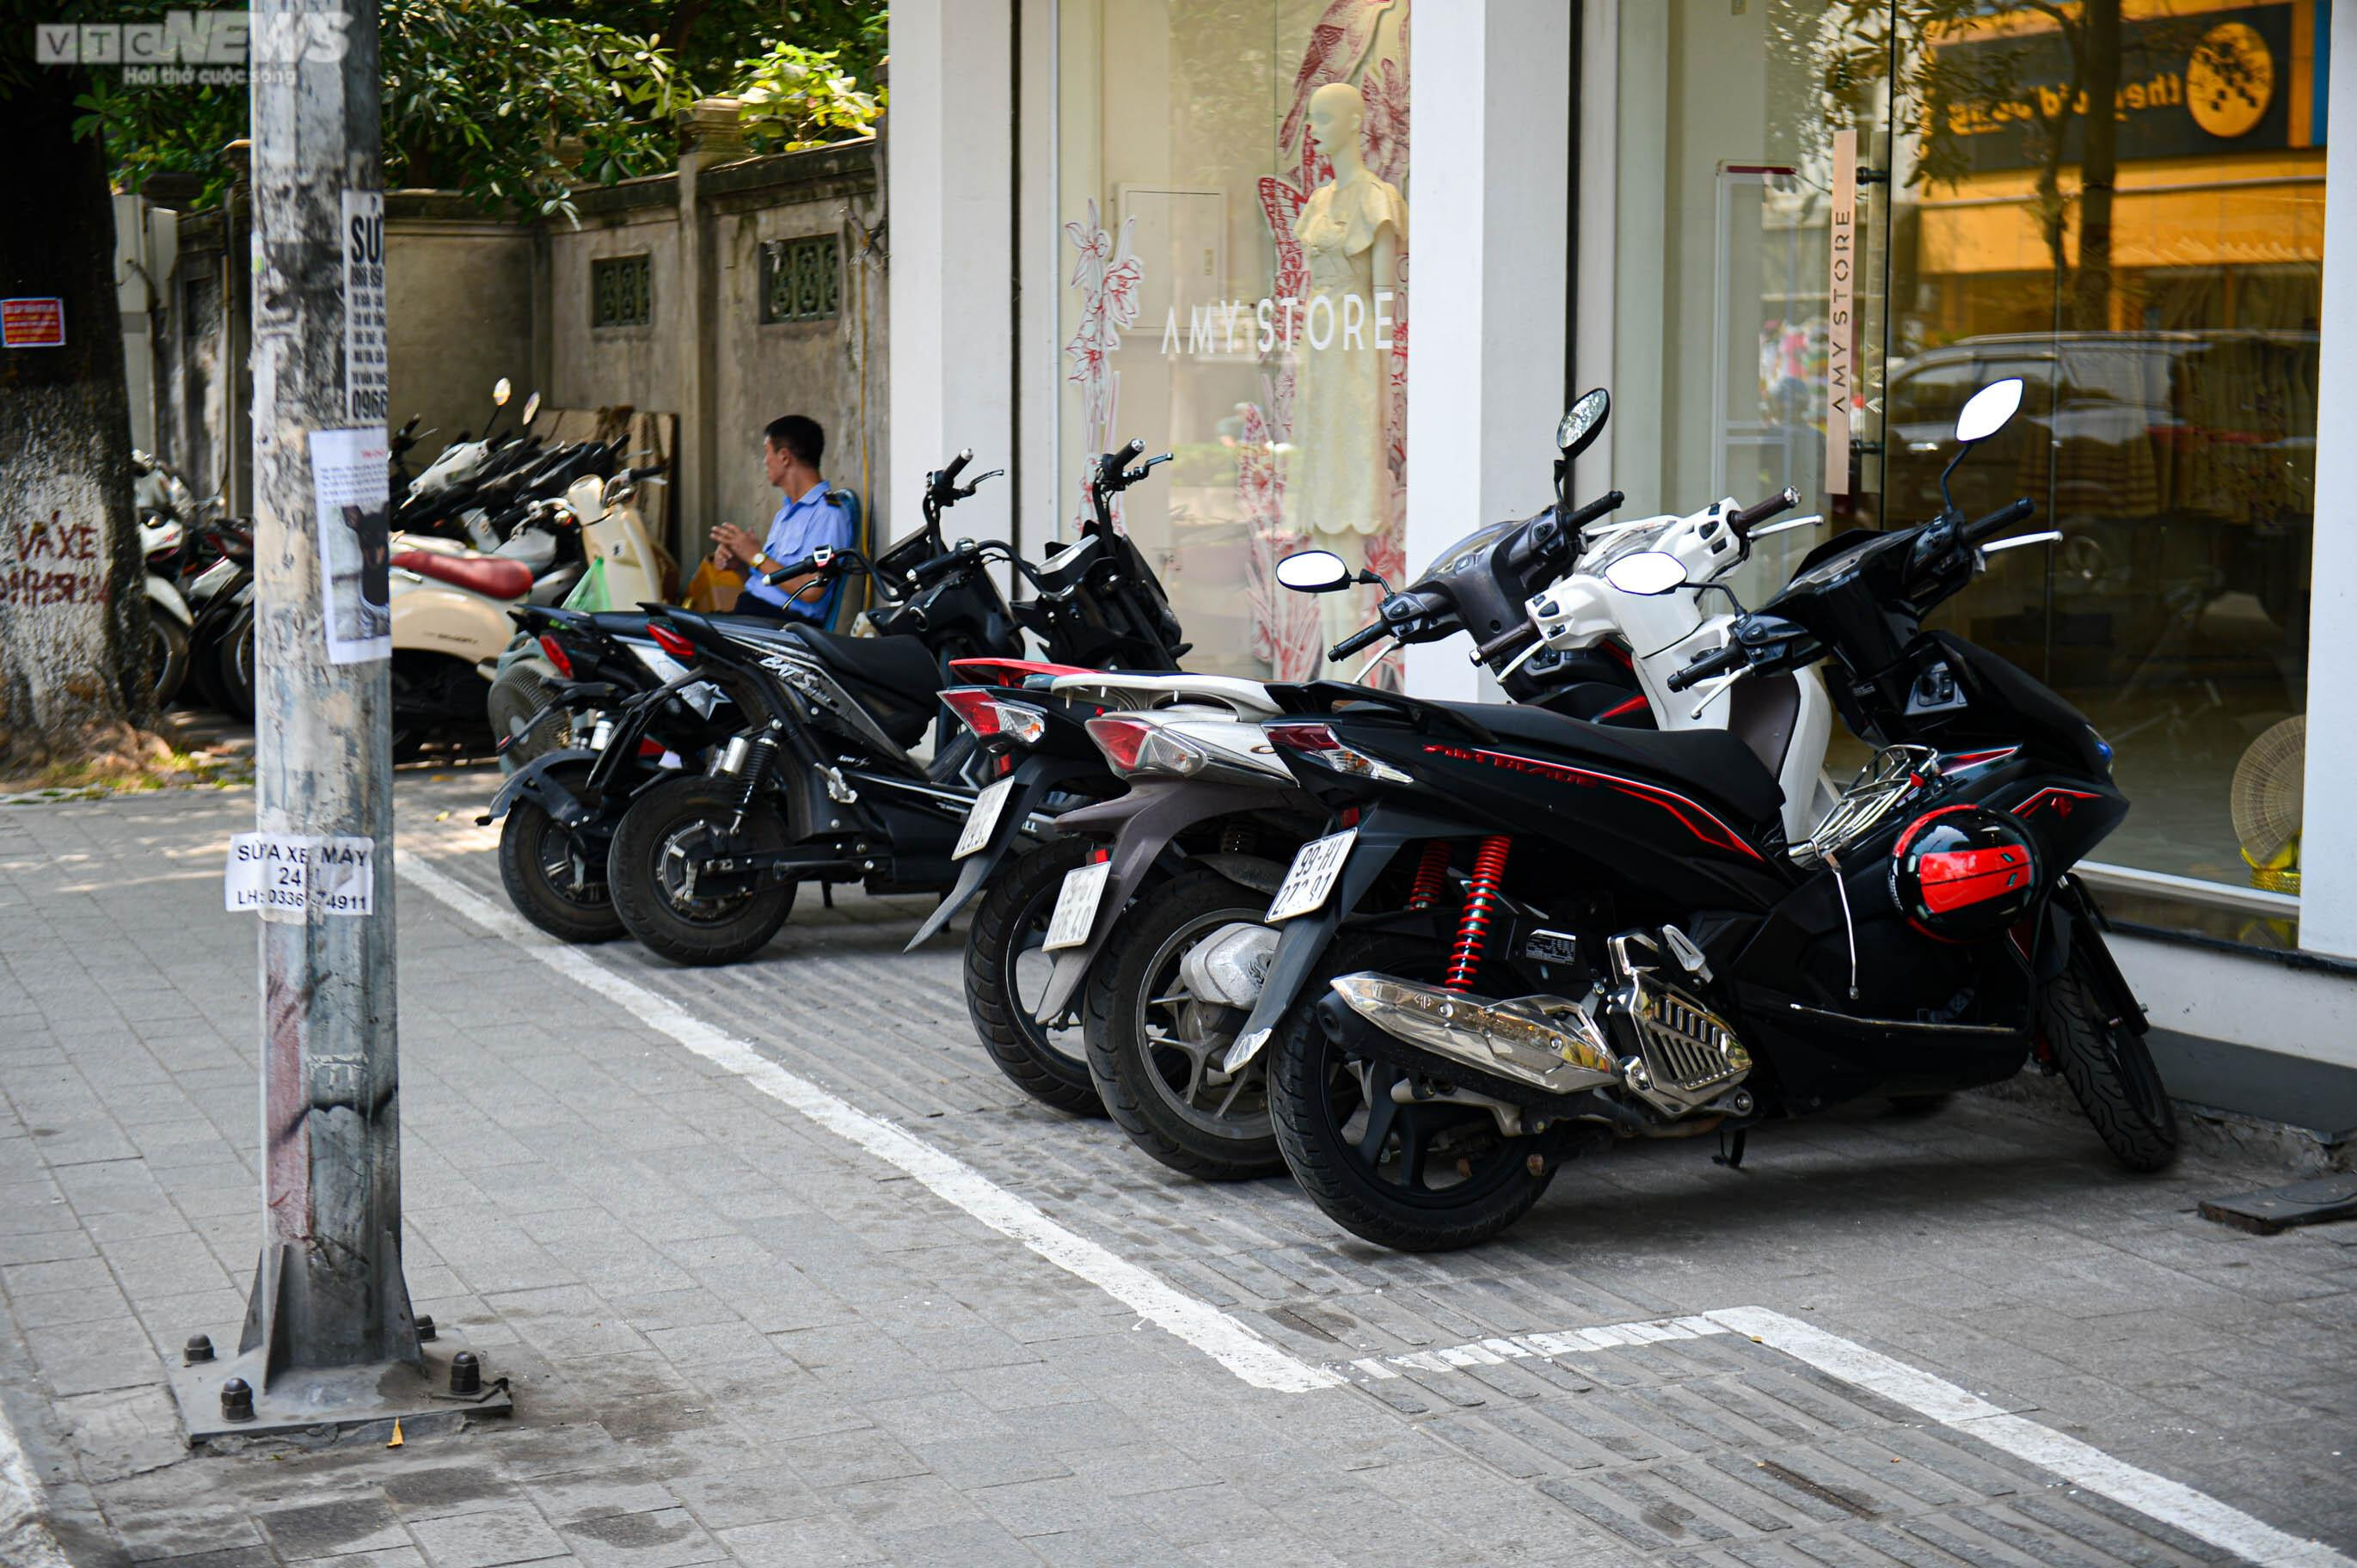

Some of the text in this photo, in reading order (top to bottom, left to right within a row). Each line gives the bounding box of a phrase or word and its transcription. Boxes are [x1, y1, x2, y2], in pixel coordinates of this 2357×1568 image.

[1832, 211, 1850, 326] STORE
[1161, 291, 1394, 354] AMY STORE
[237, 839, 281, 861] SỬA
